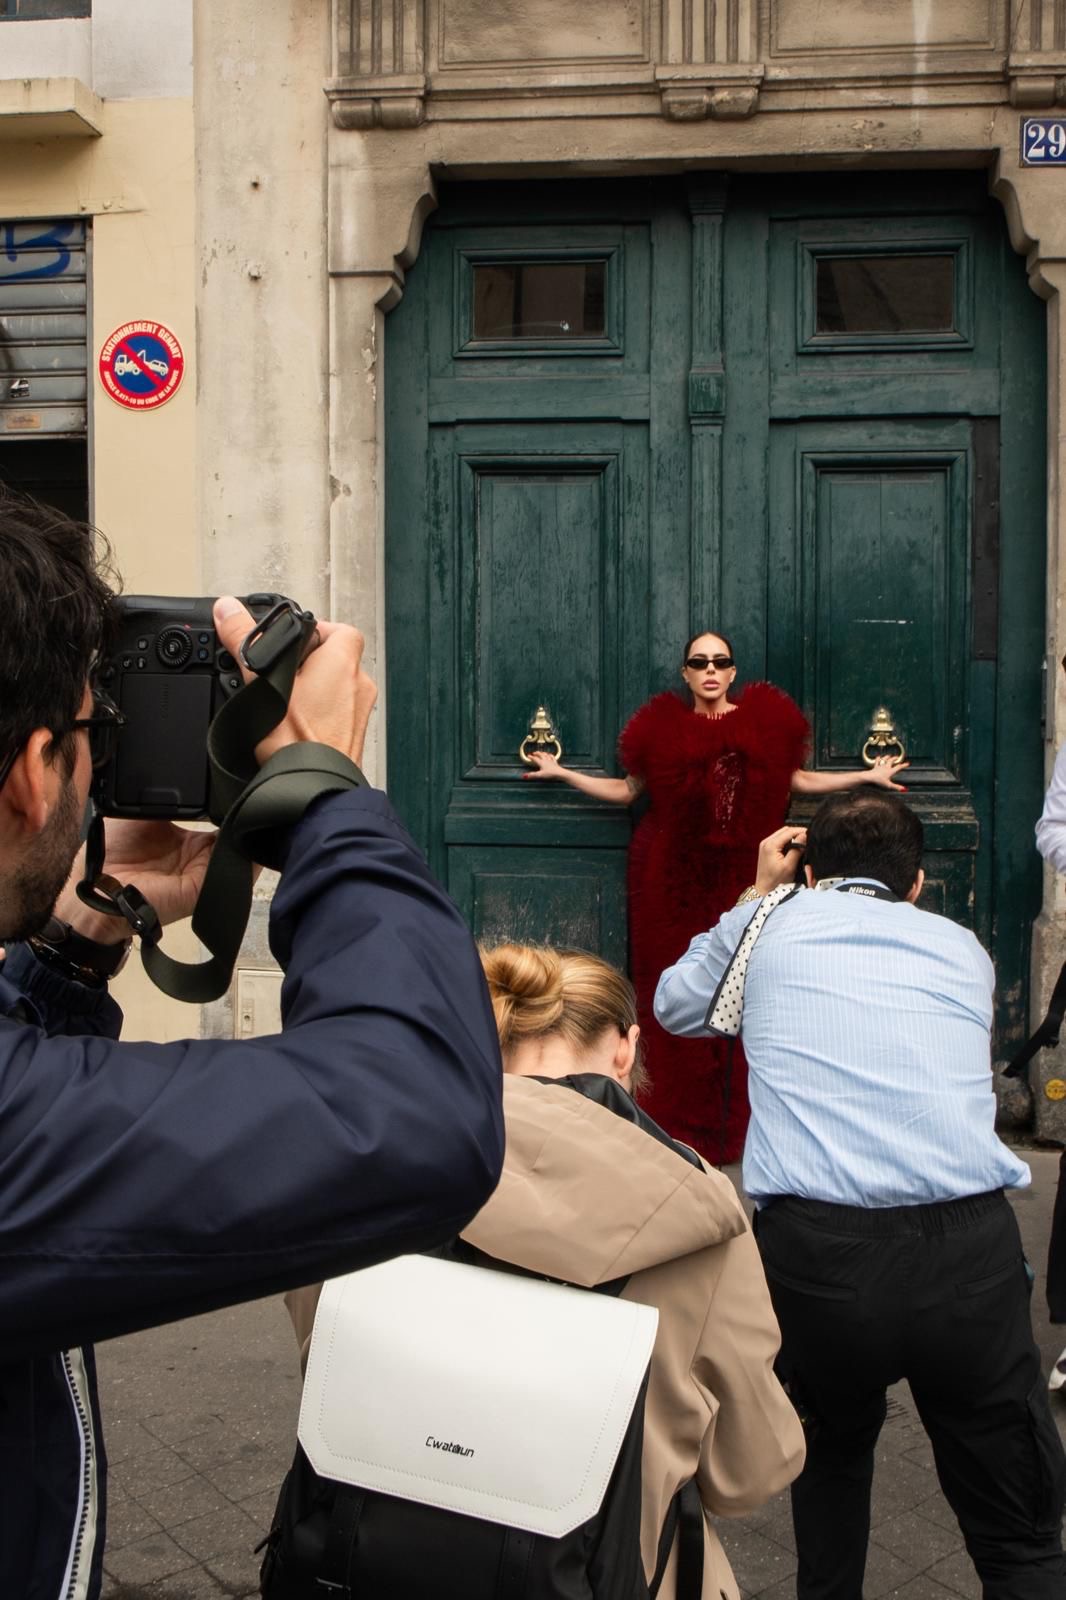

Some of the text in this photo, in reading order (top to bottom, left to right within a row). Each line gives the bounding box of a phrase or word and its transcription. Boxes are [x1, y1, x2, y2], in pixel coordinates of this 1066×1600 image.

[1027, 124, 1066, 158] 29
[101, 322, 159, 362] STATIONNEMENT
[848, 886, 876, 897] Nikon
